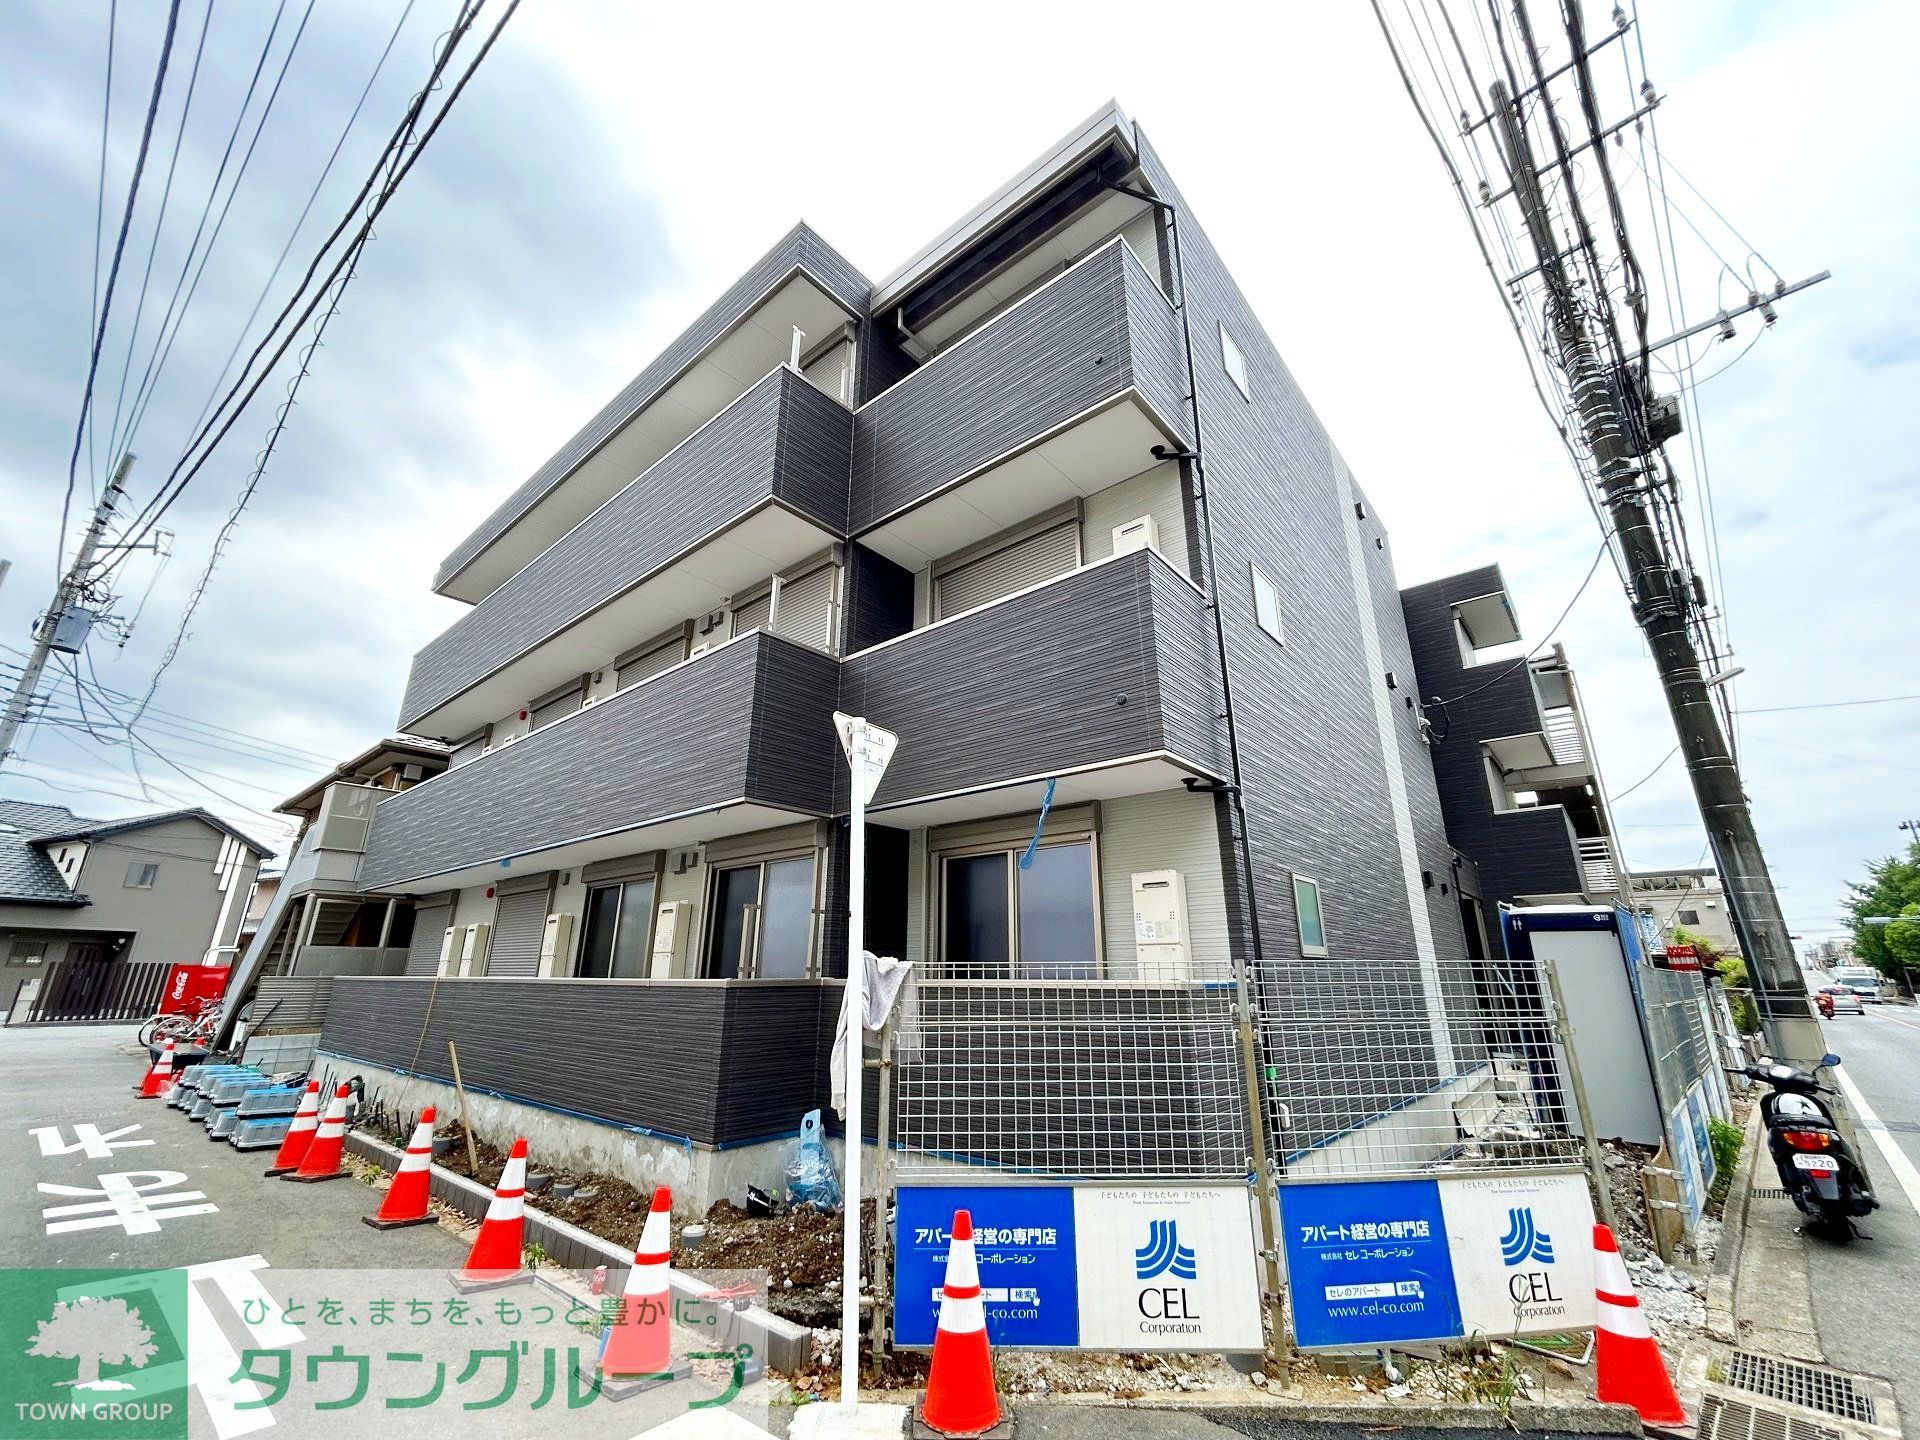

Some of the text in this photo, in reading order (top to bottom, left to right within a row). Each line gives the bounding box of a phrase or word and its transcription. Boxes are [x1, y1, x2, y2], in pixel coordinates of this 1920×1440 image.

[915, 1227, 1056, 1245] アパー経営の専門店
[1301, 1220, 1430, 1242] アパート経営の専門店
[932, 1254, 949, 1263] 株式会
[1320, 1251, 1343, 1261] 株式会社
[1329, 1285, 1381, 1298] セレのアパート
[1509, 1272, 1563, 1303] CEL
[1138, 1288, 1200, 1319] CEL
[1328, 1301, 1425, 1317] www.cel-co.com
[1139, 1321, 1202, 1336] Corporation
